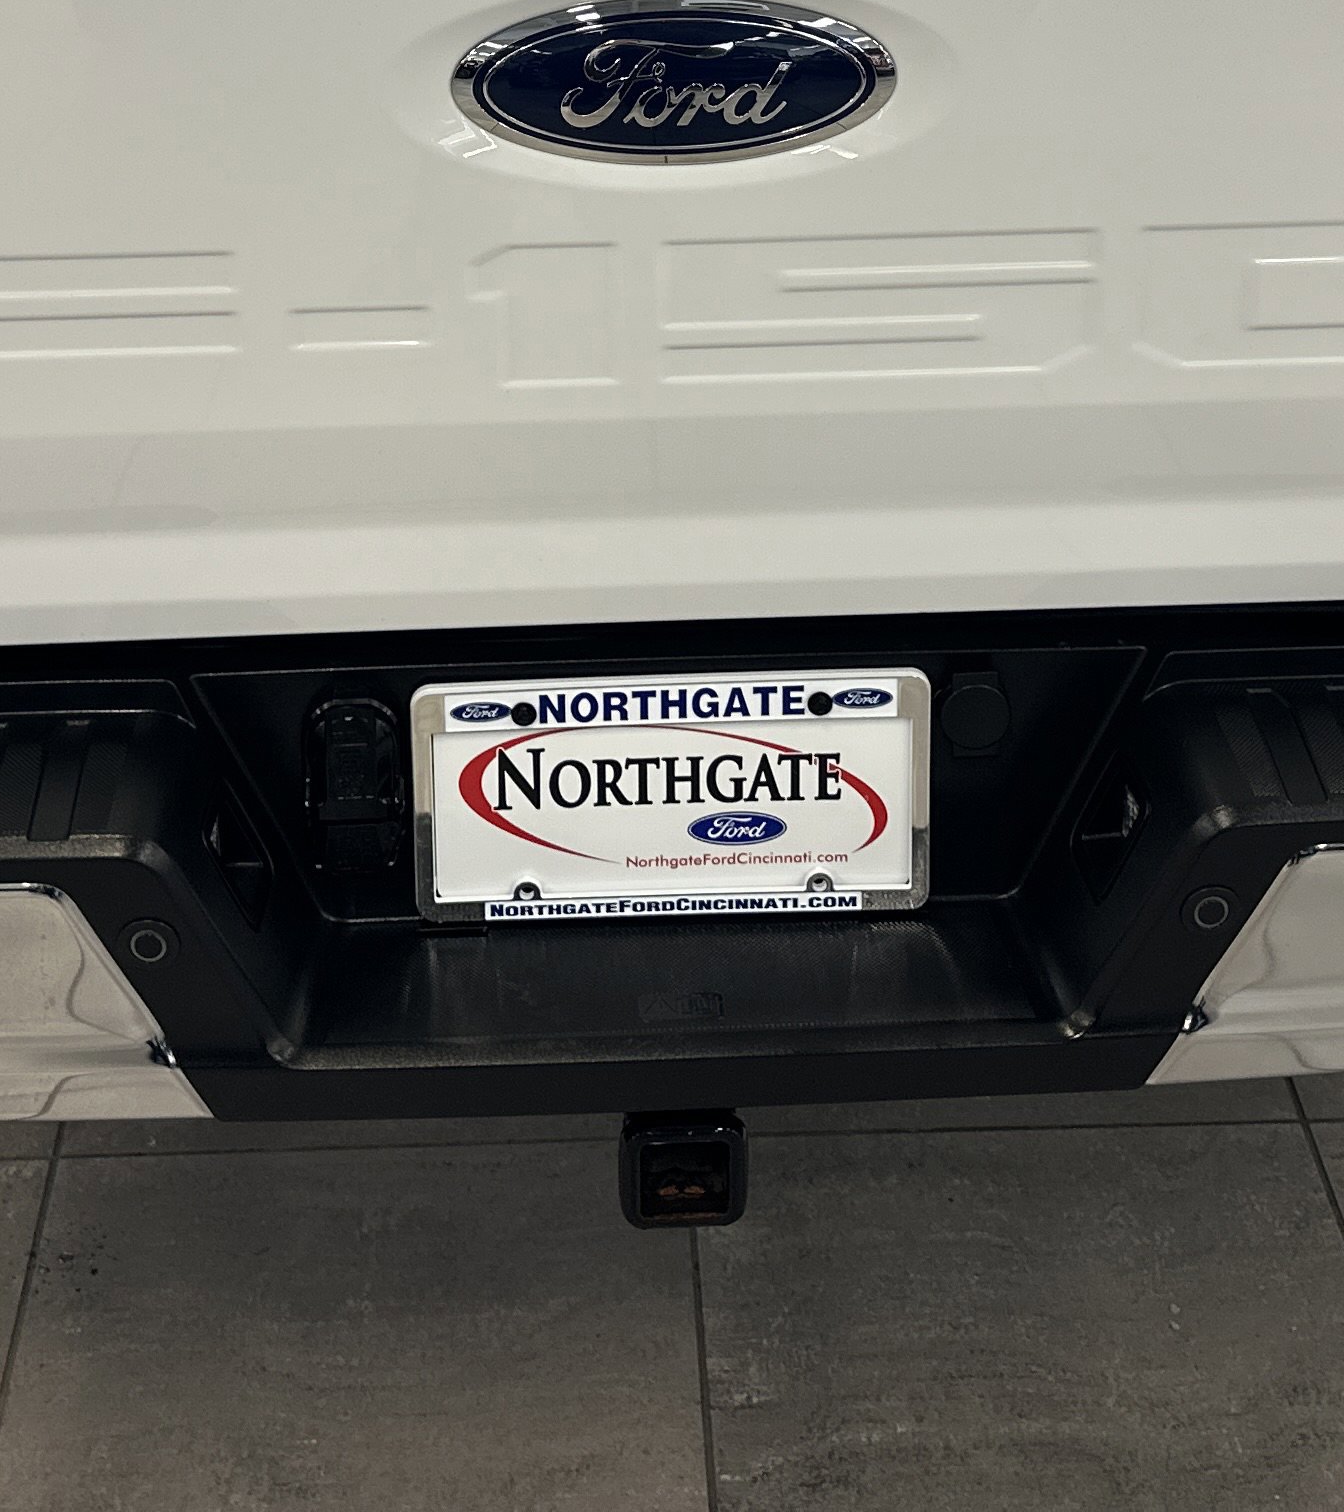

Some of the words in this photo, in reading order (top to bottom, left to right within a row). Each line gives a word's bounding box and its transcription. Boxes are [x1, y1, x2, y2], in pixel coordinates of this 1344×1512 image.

[560, 38, 792, 129] Ford
[461, 704, 499, 719] Ford
[538, 685, 806, 724] NORTHGATE
[843, 690, 881, 705] Ford
[707, 816, 766, 839] Ford
[625, 851, 849, 870] NorthgateFordCincinnati.com
